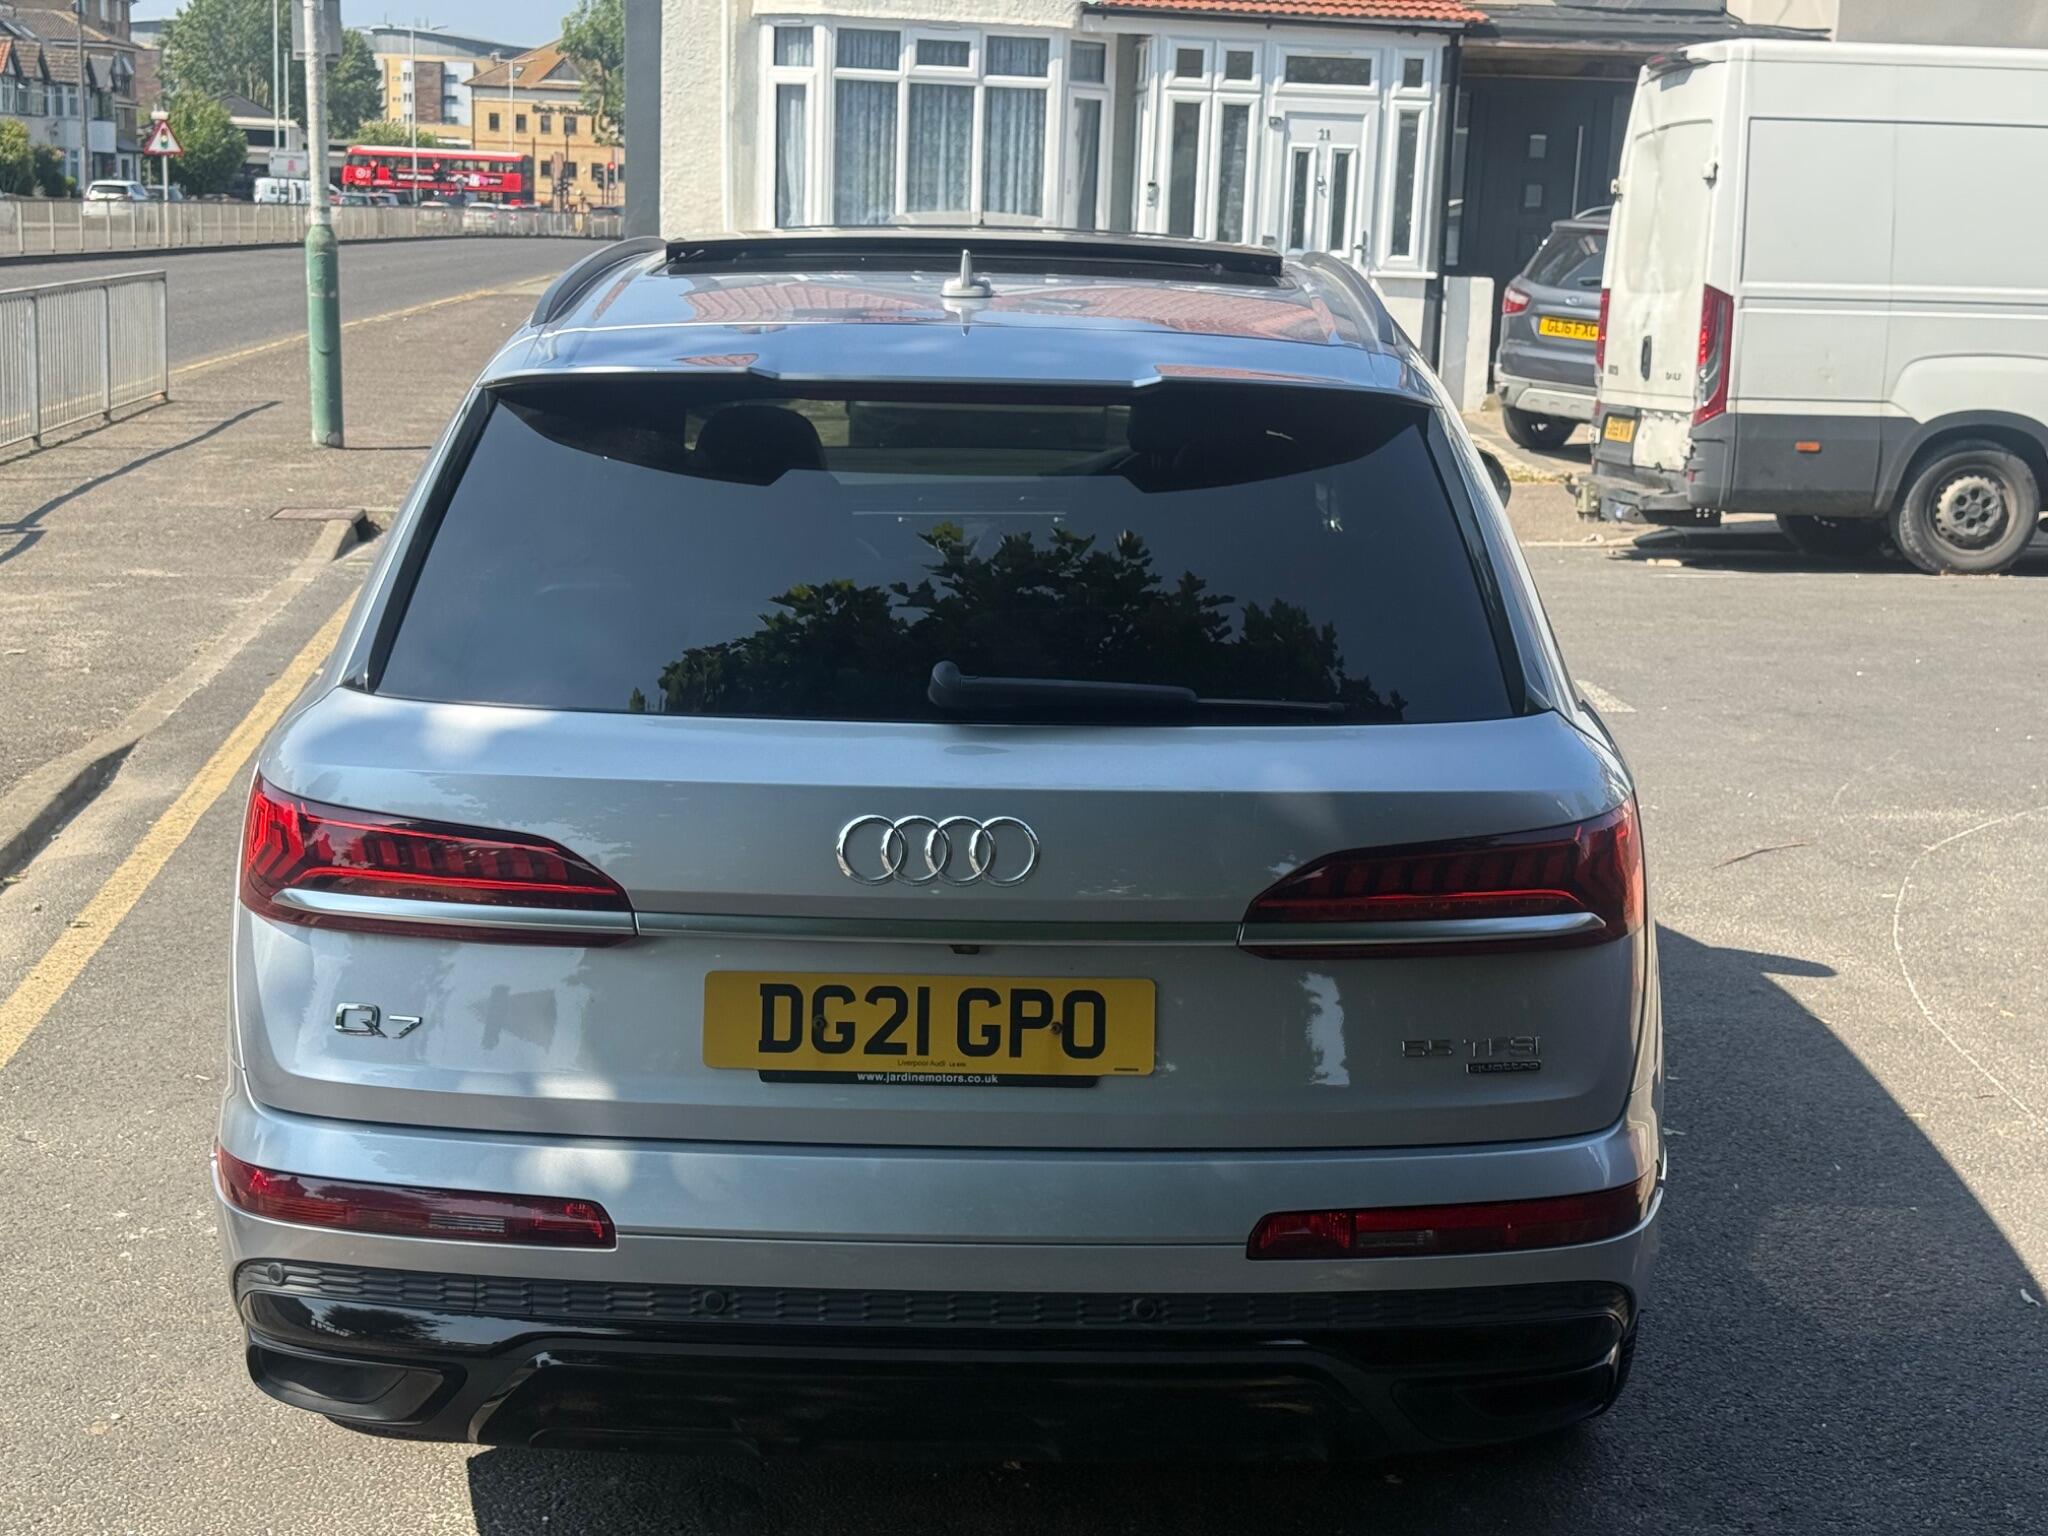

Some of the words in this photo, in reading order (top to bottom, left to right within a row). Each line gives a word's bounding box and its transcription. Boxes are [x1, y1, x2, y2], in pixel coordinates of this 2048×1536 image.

[1318, 128, 1331, 141] 21
[334, 1002, 423, 1039] Q7
[759, 983, 930, 1056] DG21
[956, 987, 1106, 1060] GPO
[1401, 1039, 1454, 1057] 55
[1463, 1035, 1542, 1057] TFSI
[897, 1059, 928, 1067] Liverpool
[930, 1059, 946, 1067] Audi
[1468, 1062, 1539, 1073] quattro
[857, 1071, 998, 1084] www.jardinemotors.co.uk
